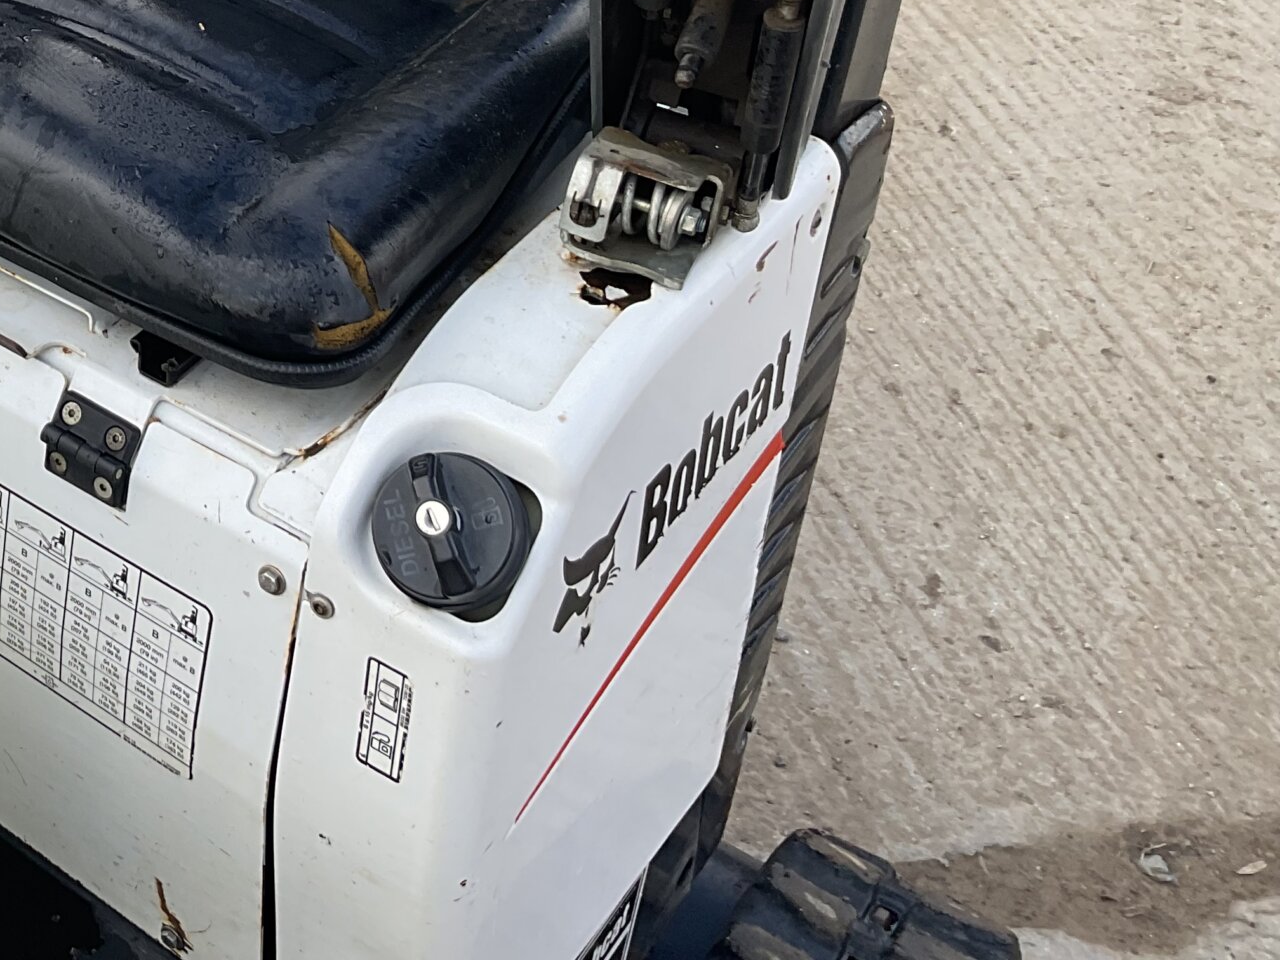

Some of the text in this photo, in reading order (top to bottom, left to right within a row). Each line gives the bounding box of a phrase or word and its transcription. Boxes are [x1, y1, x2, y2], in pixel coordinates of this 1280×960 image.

[635, 328, 792, 571] Bobcat
[383, 489, 419, 578] DIESEL
[21, 548, 28, 558] B
[85, 588, 92, 597] B
[152, 629, 159, 639] B
